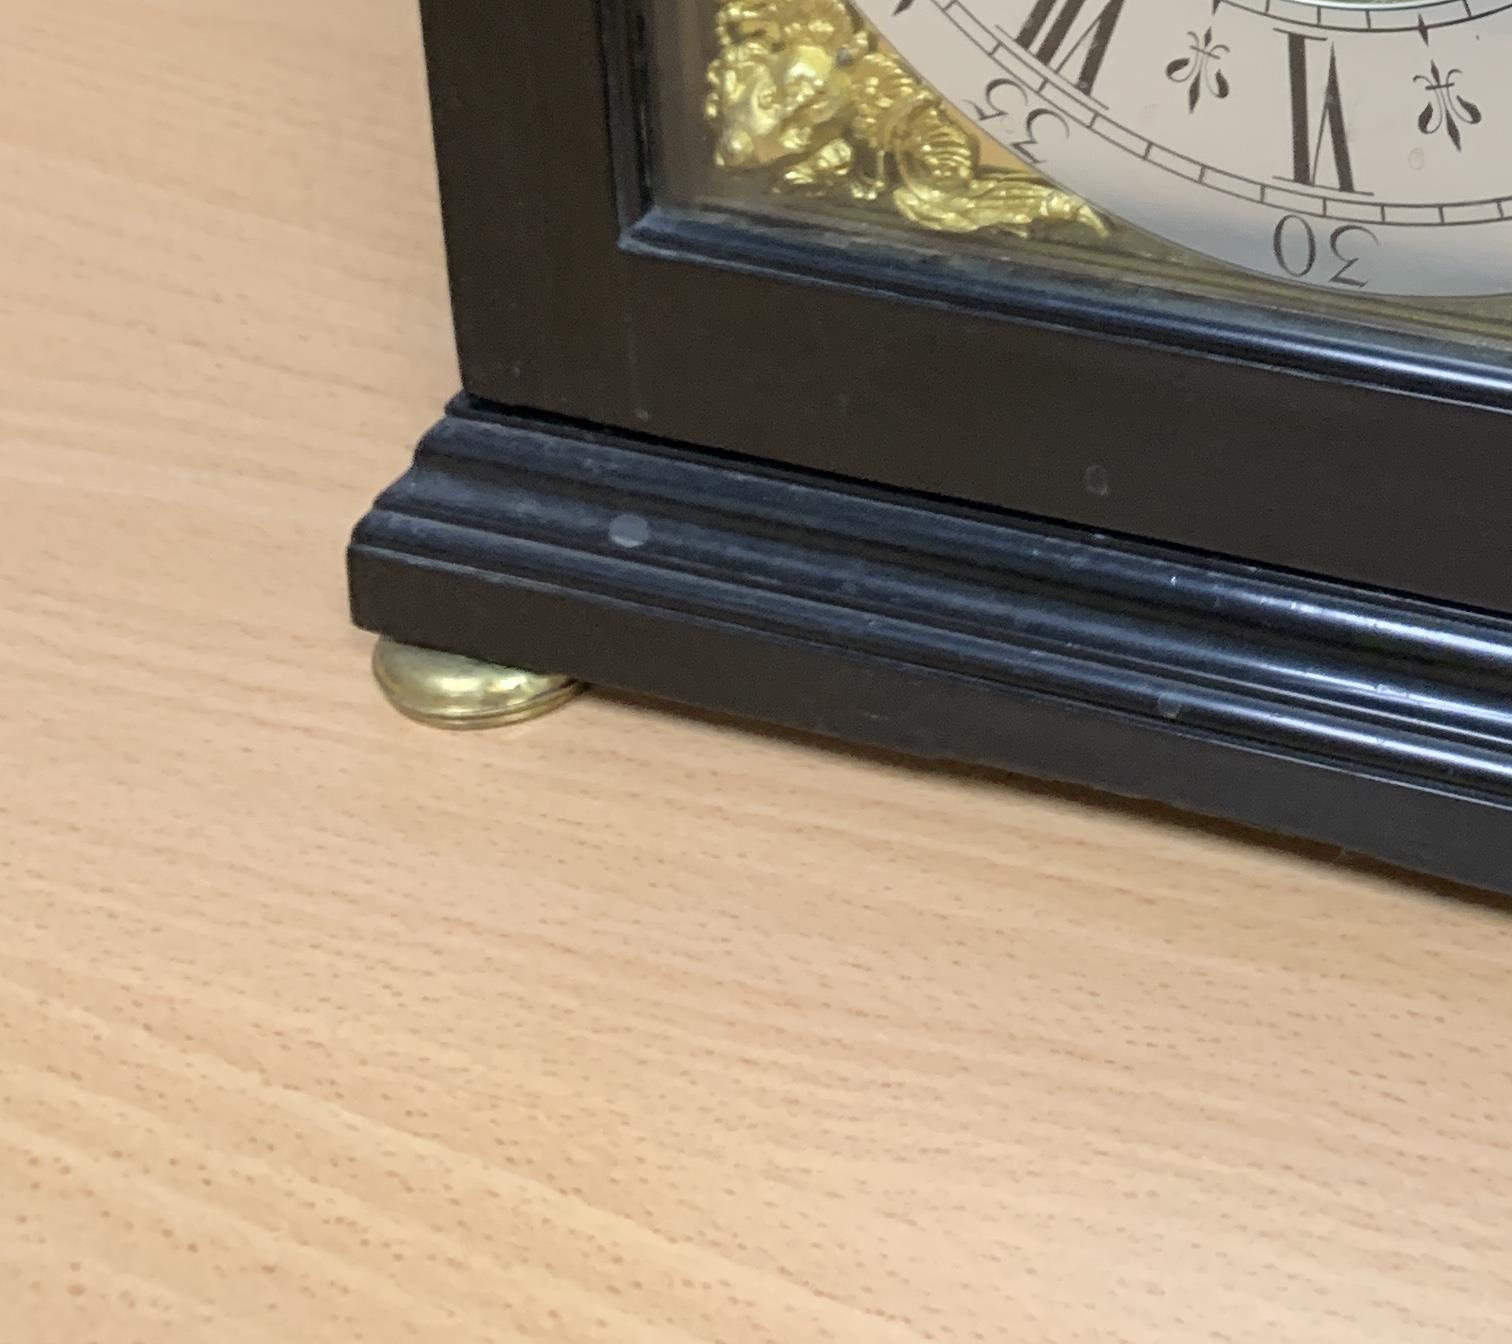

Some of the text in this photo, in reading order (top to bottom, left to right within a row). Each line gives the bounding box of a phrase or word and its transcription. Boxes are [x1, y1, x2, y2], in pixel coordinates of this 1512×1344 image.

[963, 76, 1070, 164] 35
[1271, 27, 1375, 198] VI
[1271, 213, 1379, 289] 30
